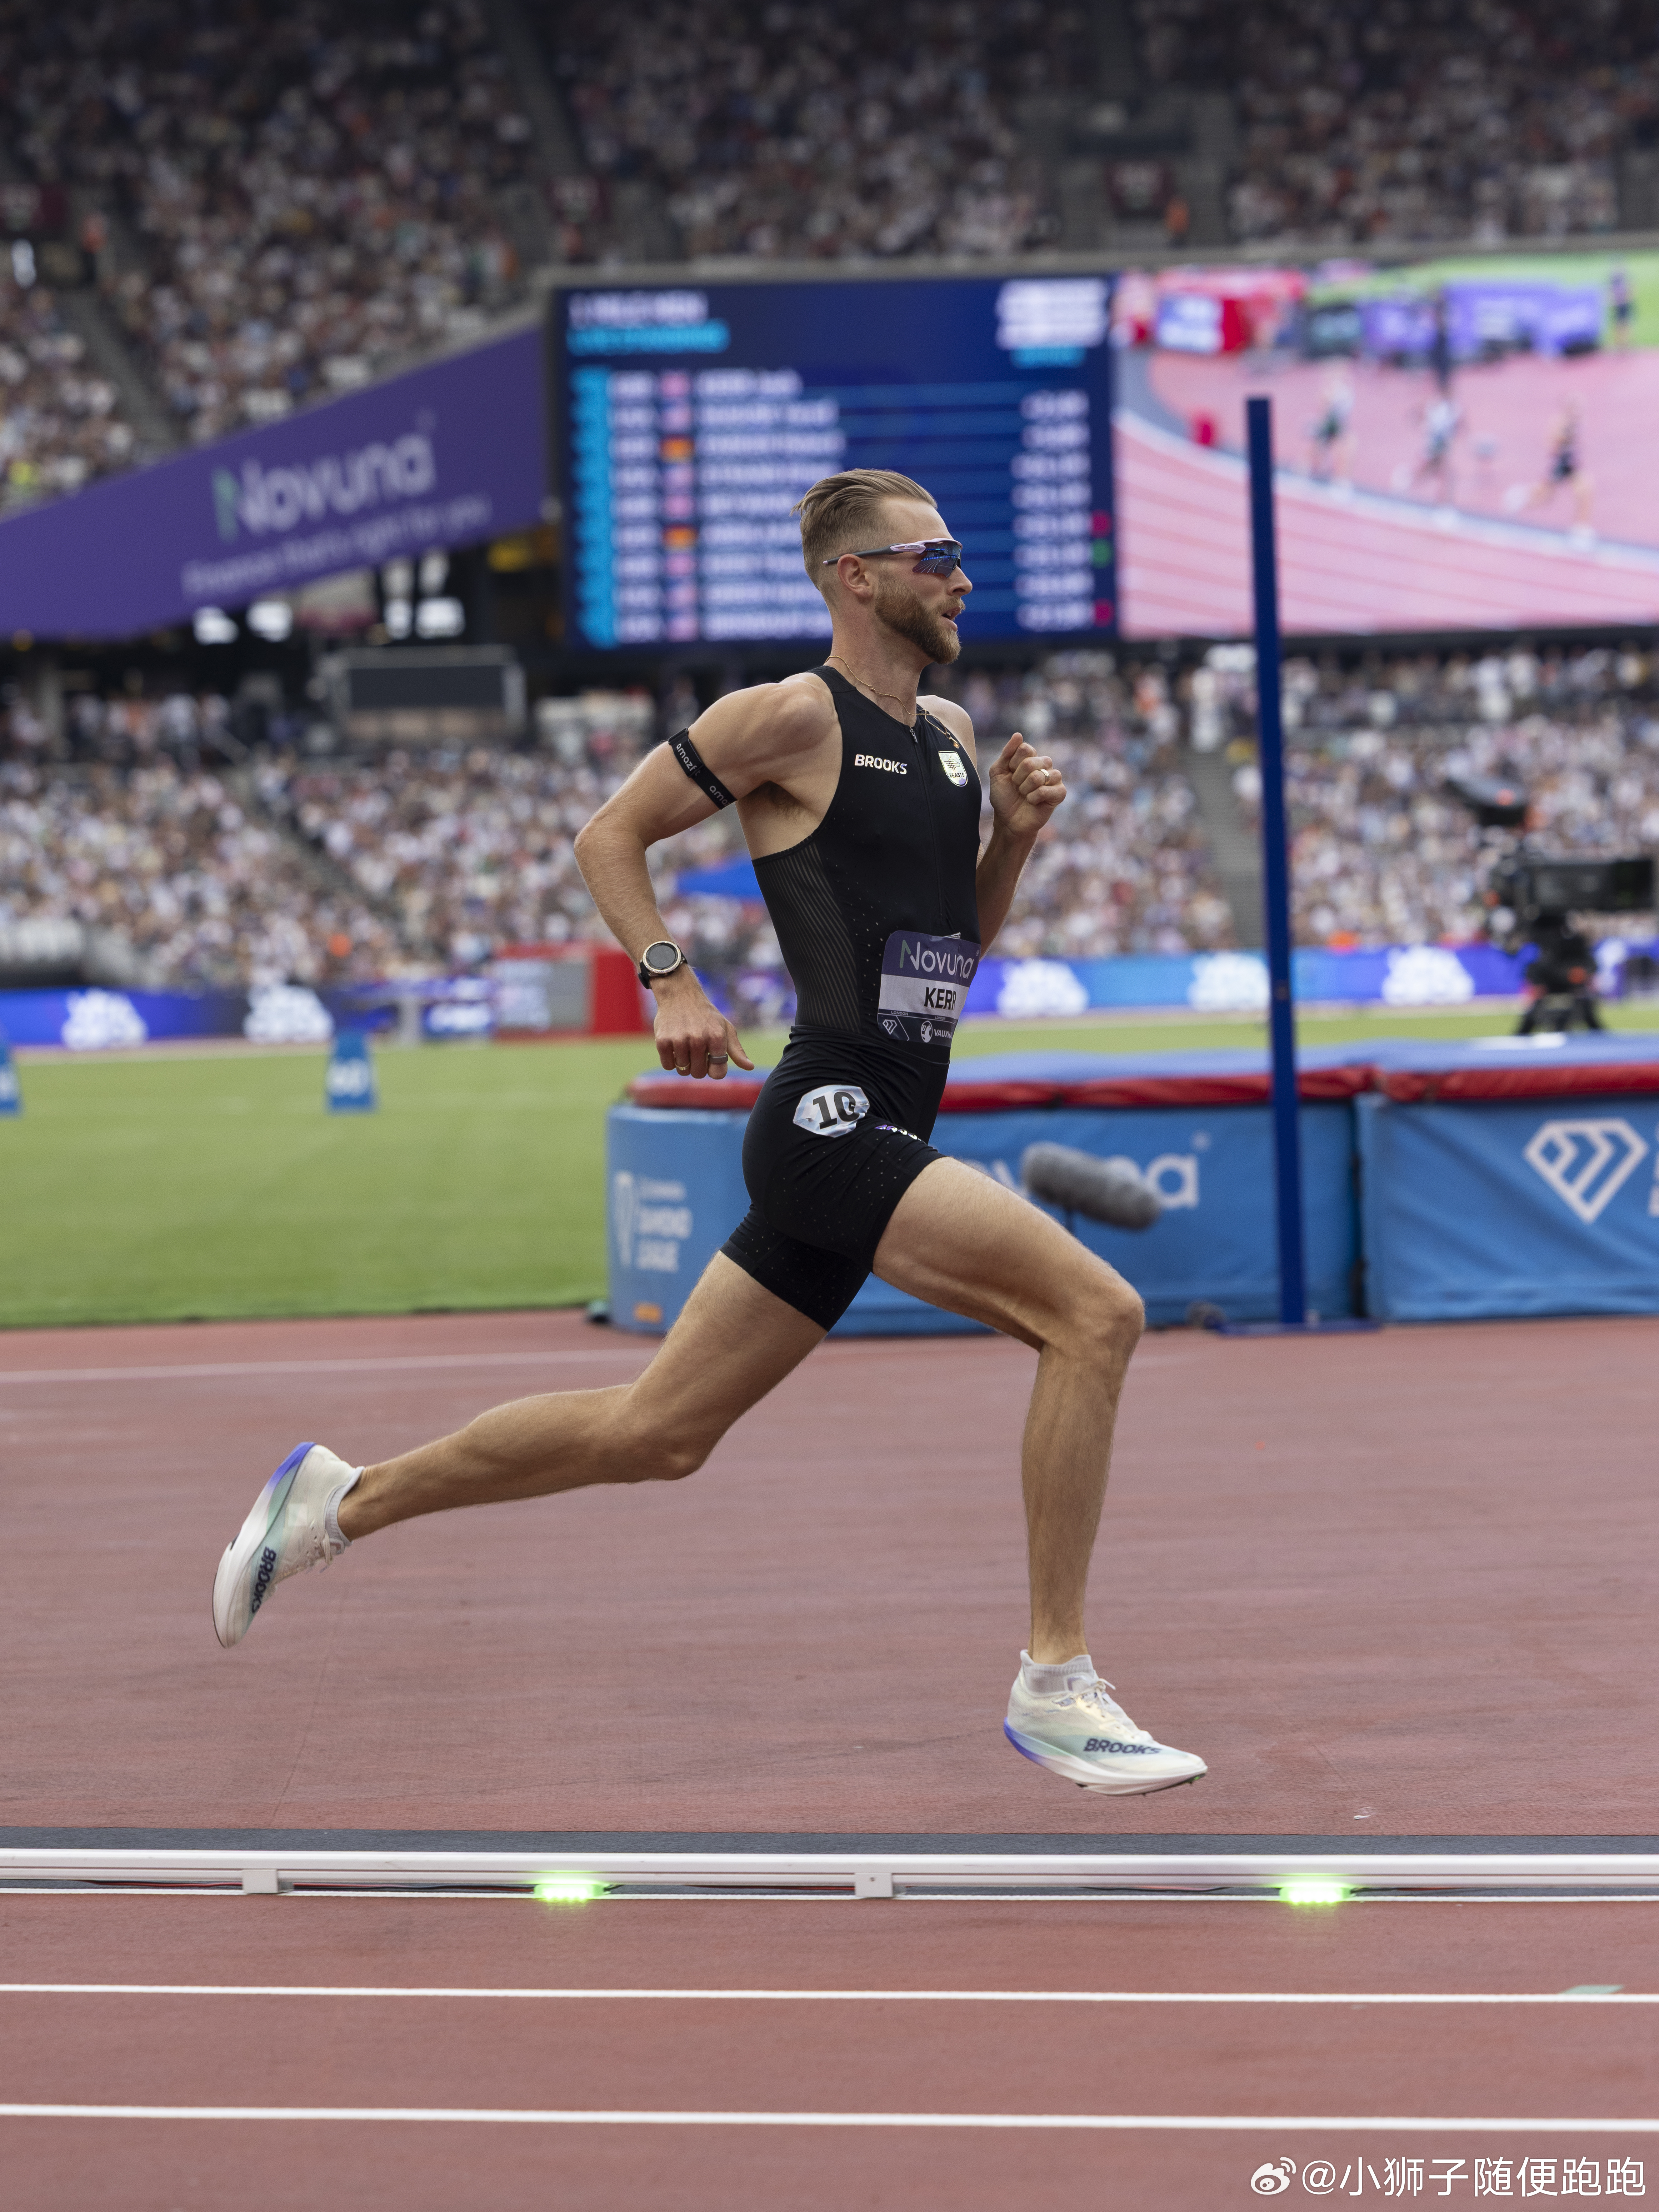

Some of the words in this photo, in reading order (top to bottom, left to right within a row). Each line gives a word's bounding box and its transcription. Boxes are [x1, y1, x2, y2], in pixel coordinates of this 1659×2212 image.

[676, 743, 700, 776] amazft
[854, 754, 907, 774] BROOKS
[899, 940, 974, 979] Novuna
[924, 987, 956, 1011] KERR
[252, 1547, 276, 1614] BROOKS
[1083, 1738, 1162, 1754] BROOKS
